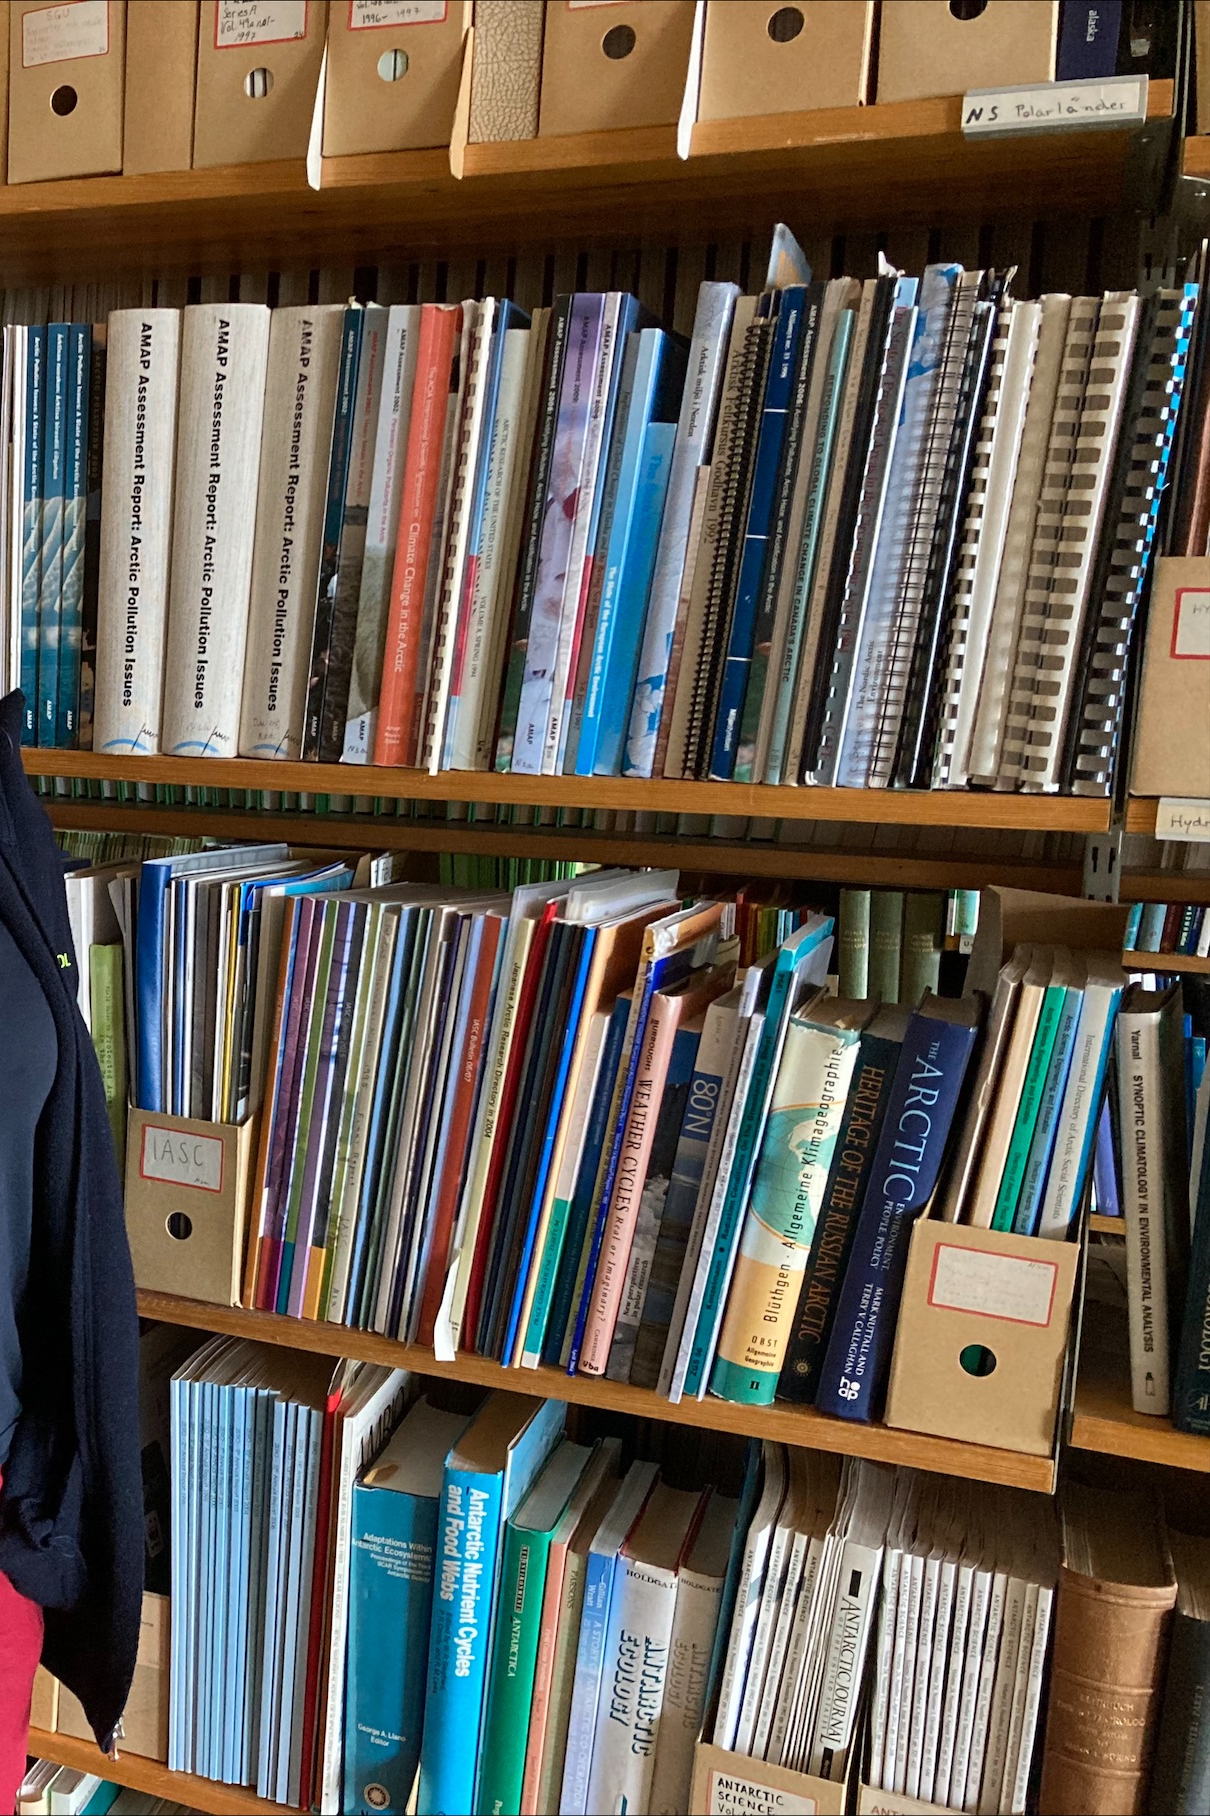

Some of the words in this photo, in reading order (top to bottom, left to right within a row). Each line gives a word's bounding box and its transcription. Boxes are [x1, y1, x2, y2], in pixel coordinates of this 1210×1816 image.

[140, 323, 152, 369] AMAP
[217, 320, 229, 366] AMAP
[300, 320, 313, 367] AMAP
[697, 347, 708, 376] Arktisk
[134, 375, 149, 469] Assessment
[210, 373, 226, 468] Assessment
[290, 373, 308, 469] Assessment
[501, 419, 509, 445] ARCTIC
[688, 408, 699, 437] Norden
[496, 448, 506, 486] RESEARCH
[709, 461, 729, 512] Godhavn
[810, 458, 822, 494] GLOBAL
[131, 475, 145, 531] Report:
[206, 473, 220, 530] Report:
[284, 475, 299, 532] Report:
[493, 500, 501, 514] THE
[495, 488, 502, 498] OF
[490, 515, 498, 539] UNITED
[703, 517, 720, 544] 1992
[802, 499, 816, 539] CLIMATE
[129, 536, 142, 581] Arctic
[203, 536, 216, 581] Arctic
[279, 537, 293, 584] Arctic
[406, 523, 420, 563] Climate
[797, 543, 809, 582] CHANGE
[400, 568, 415, 605] Change
[795, 586, 804, 596] IN
[125, 587, 139, 653] Pollution
[198, 587, 212, 654] Pollution
[272, 589, 288, 657] Pollution
[398, 623, 409, 638] the
[401, 610, 411, 618] in
[788, 599, 801, 645] CANADA'S
[394, 641, 407, 673] Arctic
[782, 648, 794, 682] ARCTIC
[123, 659, 135, 706] Issues
[194, 660, 208, 708] Issues
[267, 662, 282, 711] Issues
[508, 963, 521, 1001] Japanese
[503, 1003, 514, 1028] Arctic
[496, 1031, 510, 1068] Research
[644, 1020, 659, 1071] BURROUGHS
[927, 1042, 941, 1061] THE
[1078, 1034, 1096, 1084] International
[1131, 1030, 1142, 1060] Yarnal
[488, 1070, 504, 1107] Directory
[845, 1065, 885, 1147] HERITAGE
[1069, 1085, 1086, 1121] Directory
[1133, 1075, 1145, 1126] SYNOPTIC
[483, 1118, 495, 1138] 2004
[625, 1080, 653, 1150] WEATHER
[883, 1055, 944, 1201] ARCTIC
[1069, 1123, 1078, 1134] of
[153, 1136, 204, 1167] IASC
[840, 1150, 864, 1173] OF
[1063, 1134, 1077, 1156] Arctic
[1135, 1129, 1148, 1199] CLIMATOLOGY
[614, 1156, 638, 1212] CYCLES
[763, 1264, 791, 1323] Blüthgen
[781, 1173, 813, 1250] Allgemeine
[801, 1050, 844, 1167] Klimageographie
[1059, 1158, 1072, 1183] Social
[830, 1177, 860, 1208] THE
[1051, 1184, 1068, 1220] Scientists
[1139, 1203, 1148, 1214] IN
[612, 1216, 624, 1241] Real
[816, 1212, 850, 1282] RUSSIAN
[609, 1245, 618, 1256] or
[870, 1236, 886, 1269] POLICY
[1139, 1217, 1152, 1301] ENVIRONMENTAL
[596, 1261, 616, 1322] Imaginary?
[625, 1258, 640, 1300] perspectives
[636, 1260, 648, 1290] research
[622, 1302, 632, 1316] New
[633, 1291, 643, 1309] polar
[798, 1281, 830, 1344] ARCTIC
[859, 1283, 874, 1310] TERRY
[870, 1287, 884, 1313] MARK
[751, 1336, 778, 1348] OBST
[843, 1320, 864, 1376] CALLAGHAN
[860, 1314, 877, 1354] NUTTALL
[1142, 1304, 1154, 1353] ANALYSIS
[747, 1347, 777, 1358] Allgemeine
[852, 1354, 867, 1375] AND
[446, 1485, 465, 1516] and
[443, 1517, 463, 1558] Food
[464, 1489, 489, 1560] Antarctic
[439, 1560, 461, 1601] Webs
[459, 1562, 483, 1623] Nutrient
[566, 1570, 579, 1609] PARSONS
[454, 1626, 478, 1677] Cycles
[507, 1616, 521, 1677] ANTARCTICA
[832, 1597, 863, 1681] ANTARCTIC
[609, 1630, 641, 1727] ECOLOGY
[632, 1636, 667, 1757] ANTARCTIC
[819, 1681, 851, 1746] JOURNAL
[717, 1777, 784, 1806] ANTARCTIC
[717, 1791, 774, 1815] SCIENCE
